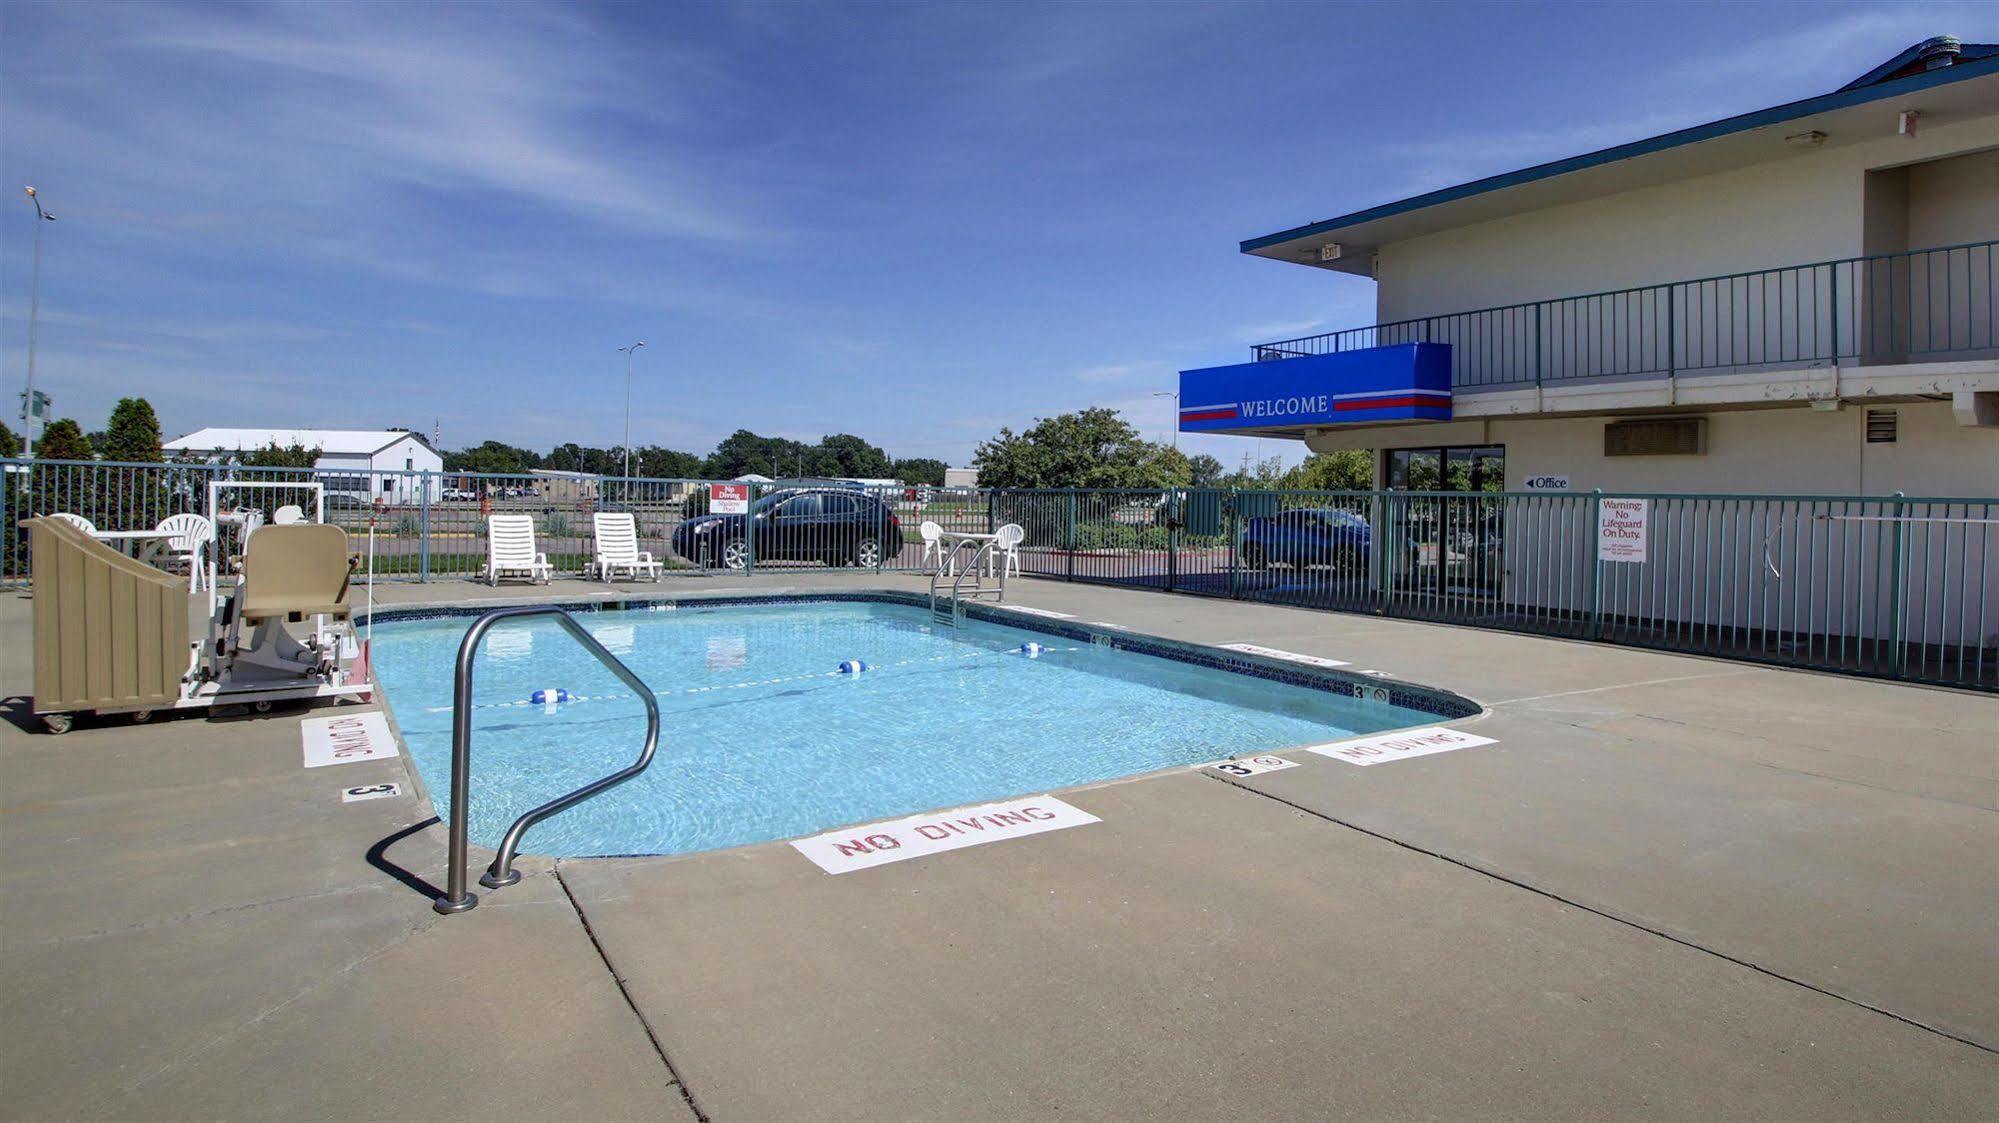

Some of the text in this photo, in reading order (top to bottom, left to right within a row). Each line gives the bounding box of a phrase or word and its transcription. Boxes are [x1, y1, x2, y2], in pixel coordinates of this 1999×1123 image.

[1241, 396, 1328, 418] WELCOME
[1536, 477, 1567, 489] Office
[1616, 511, 1629, 519] No
[1602, 519, 1642, 529] Lifeguard
[1603, 529, 1617, 538] On
[1336, 746, 1383, 758] NO
[832, 806, 1056, 857] NO DIVING
